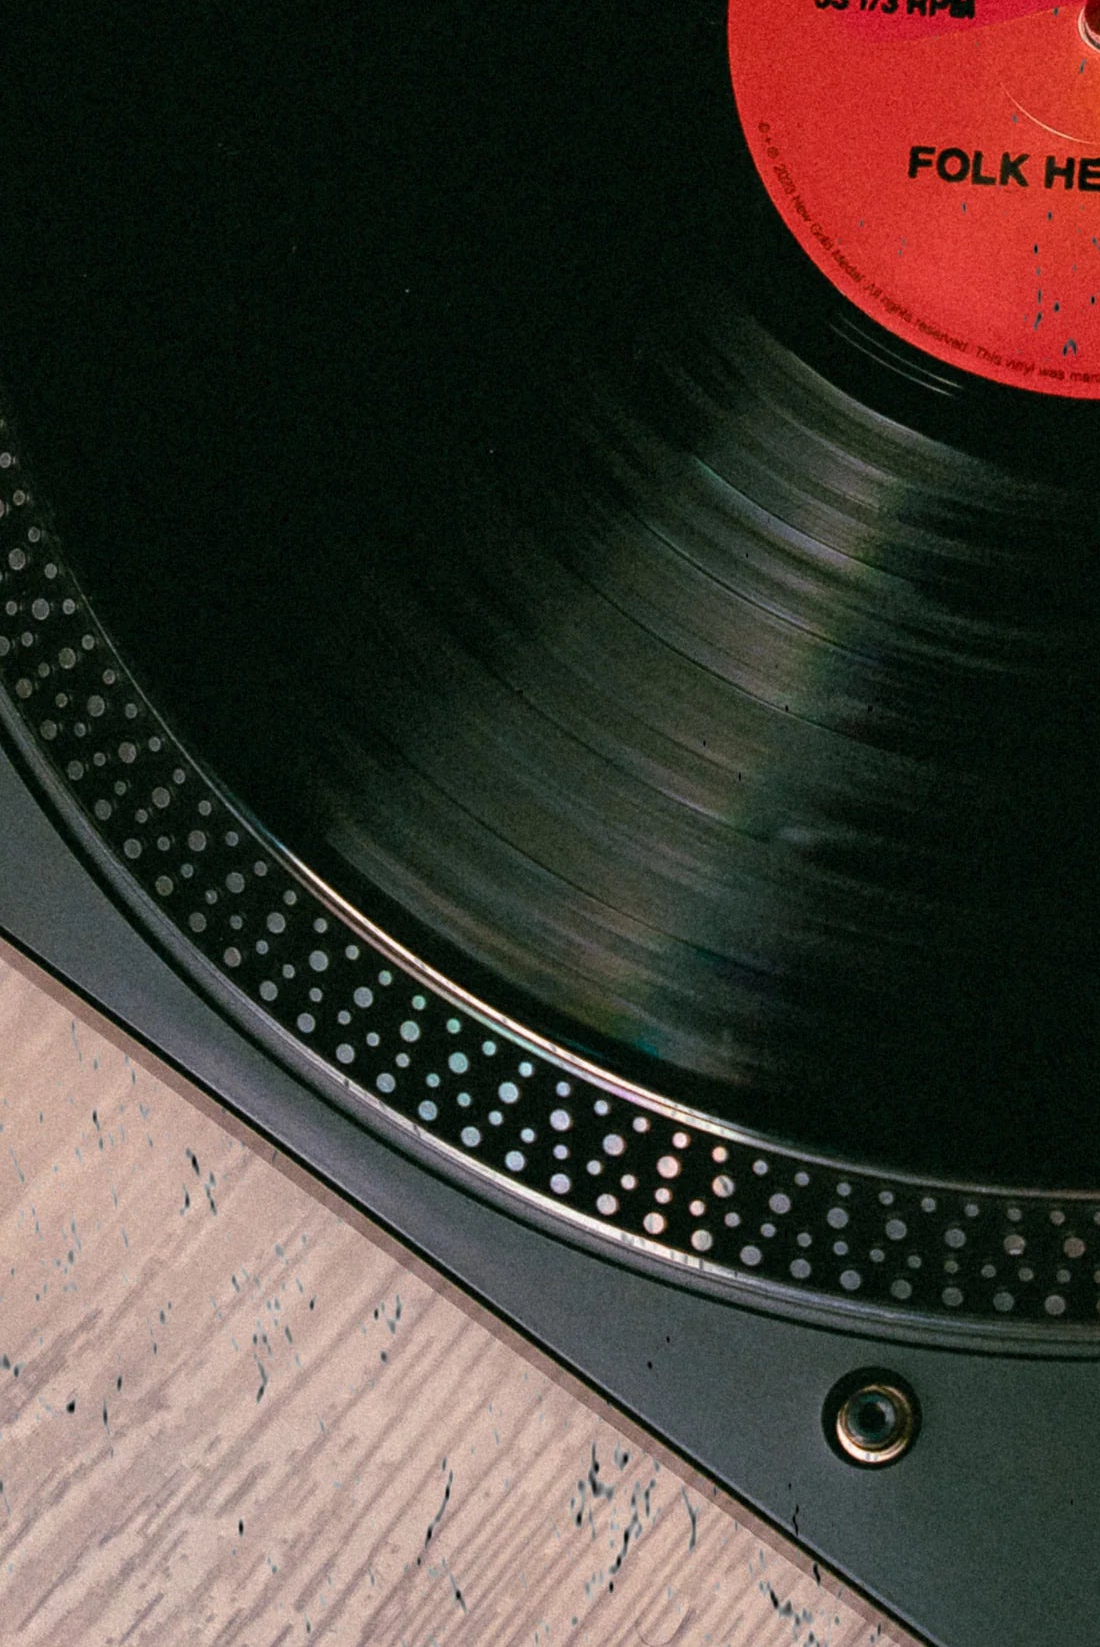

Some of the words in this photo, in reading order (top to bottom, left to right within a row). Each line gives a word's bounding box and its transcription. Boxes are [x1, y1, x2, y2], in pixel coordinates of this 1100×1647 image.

[908, 146, 1029, 187] FOLK
[791, 194, 812, 222] New
[862, 282, 884, 300] All
[880, 295, 913, 324] rights
[975, 345, 1003, 366] This
[1005, 358, 1036, 376] vinyl
[1038, 368, 1066, 380] was
